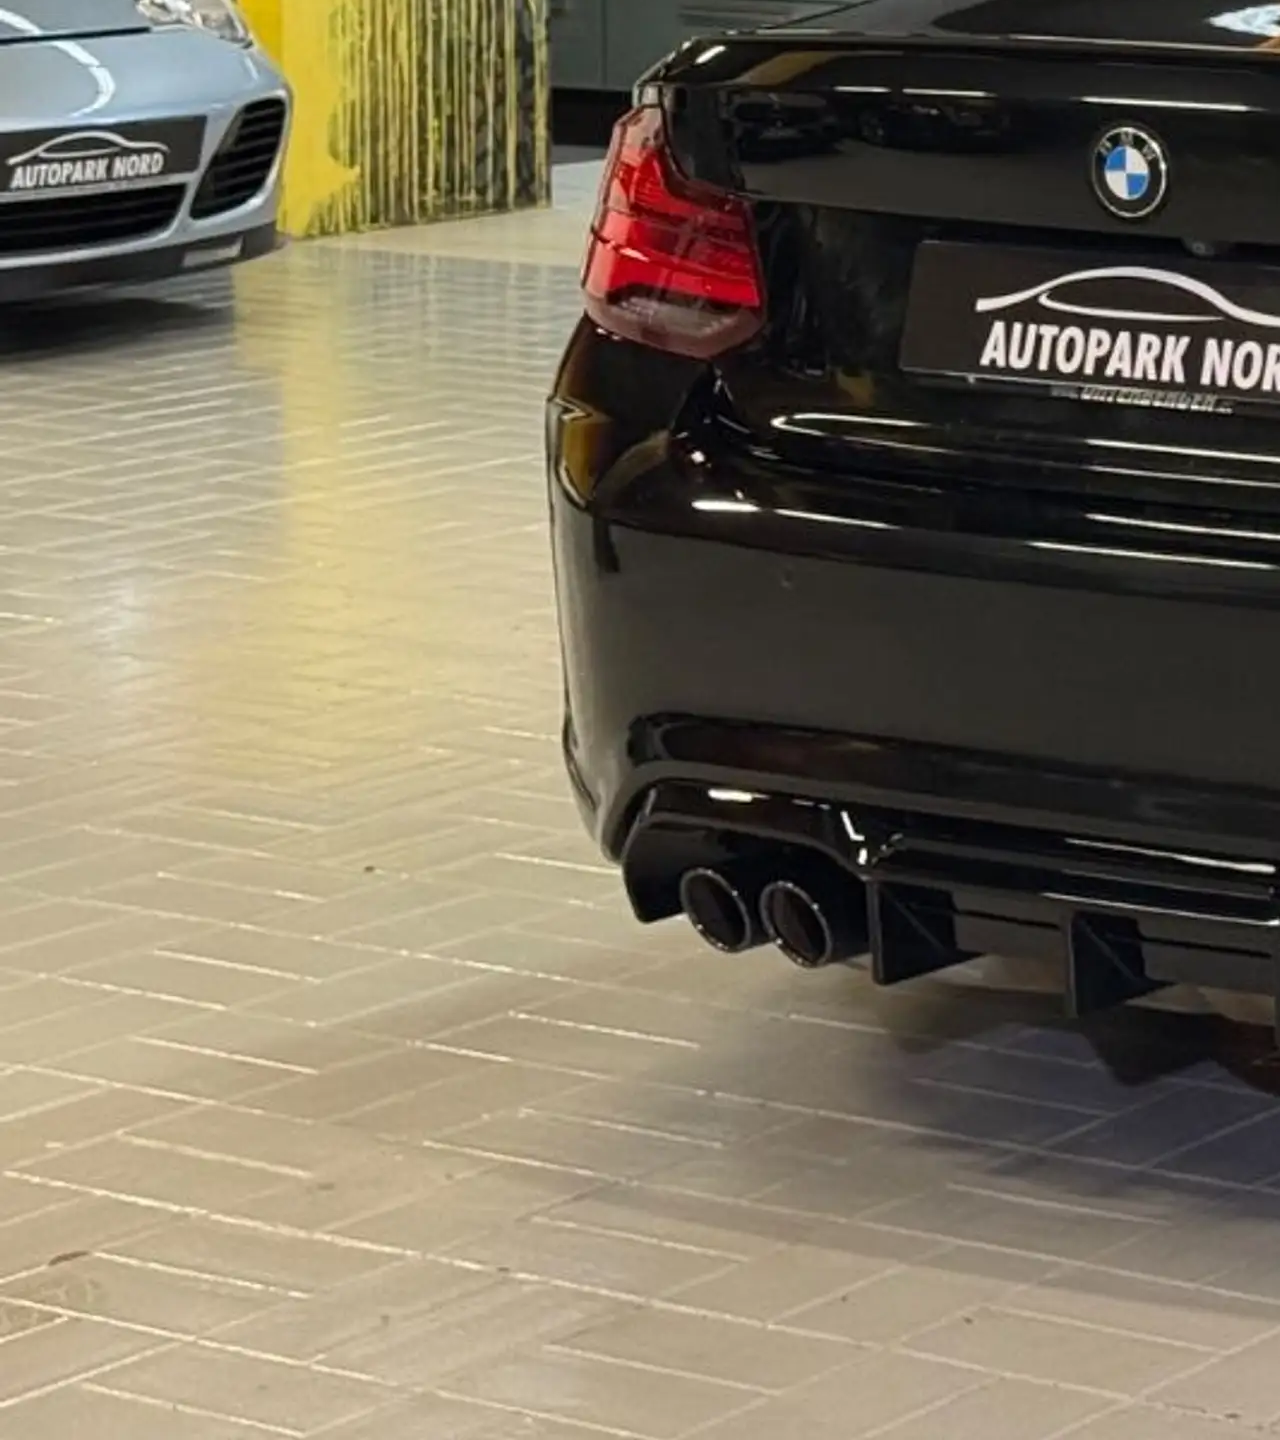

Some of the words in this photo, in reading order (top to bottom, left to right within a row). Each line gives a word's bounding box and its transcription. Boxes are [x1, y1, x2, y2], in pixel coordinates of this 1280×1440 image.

[10, 158, 110, 189] AUTOPARK
[112, 152, 164, 178] NORD
[979, 320, 1191, 384] AUTOPARK
